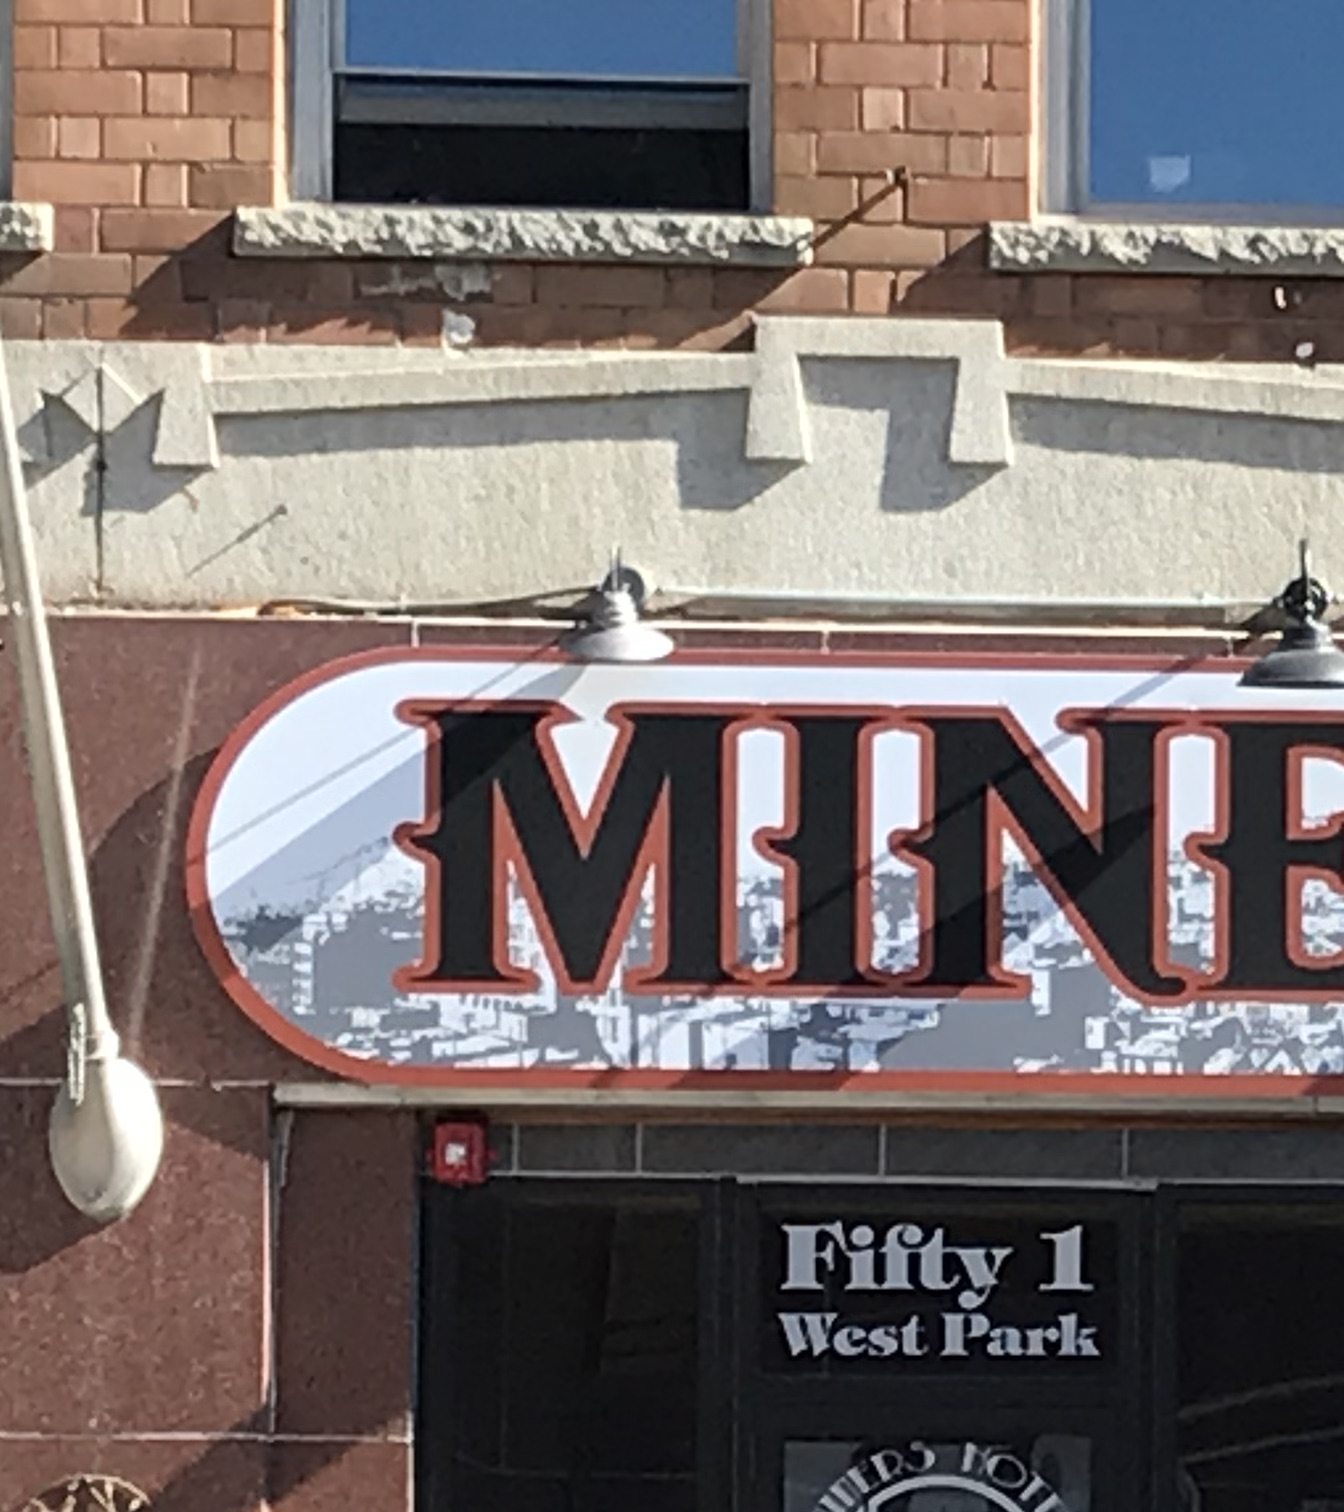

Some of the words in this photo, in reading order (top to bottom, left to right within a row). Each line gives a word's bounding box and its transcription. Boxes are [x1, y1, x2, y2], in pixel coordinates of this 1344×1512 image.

[780, 1221, 1013, 1310] Fifty
[1038, 1225, 1094, 1292] 1
[778, 1312, 929, 1358] West
[940, 1312, 1101, 1358] Park
